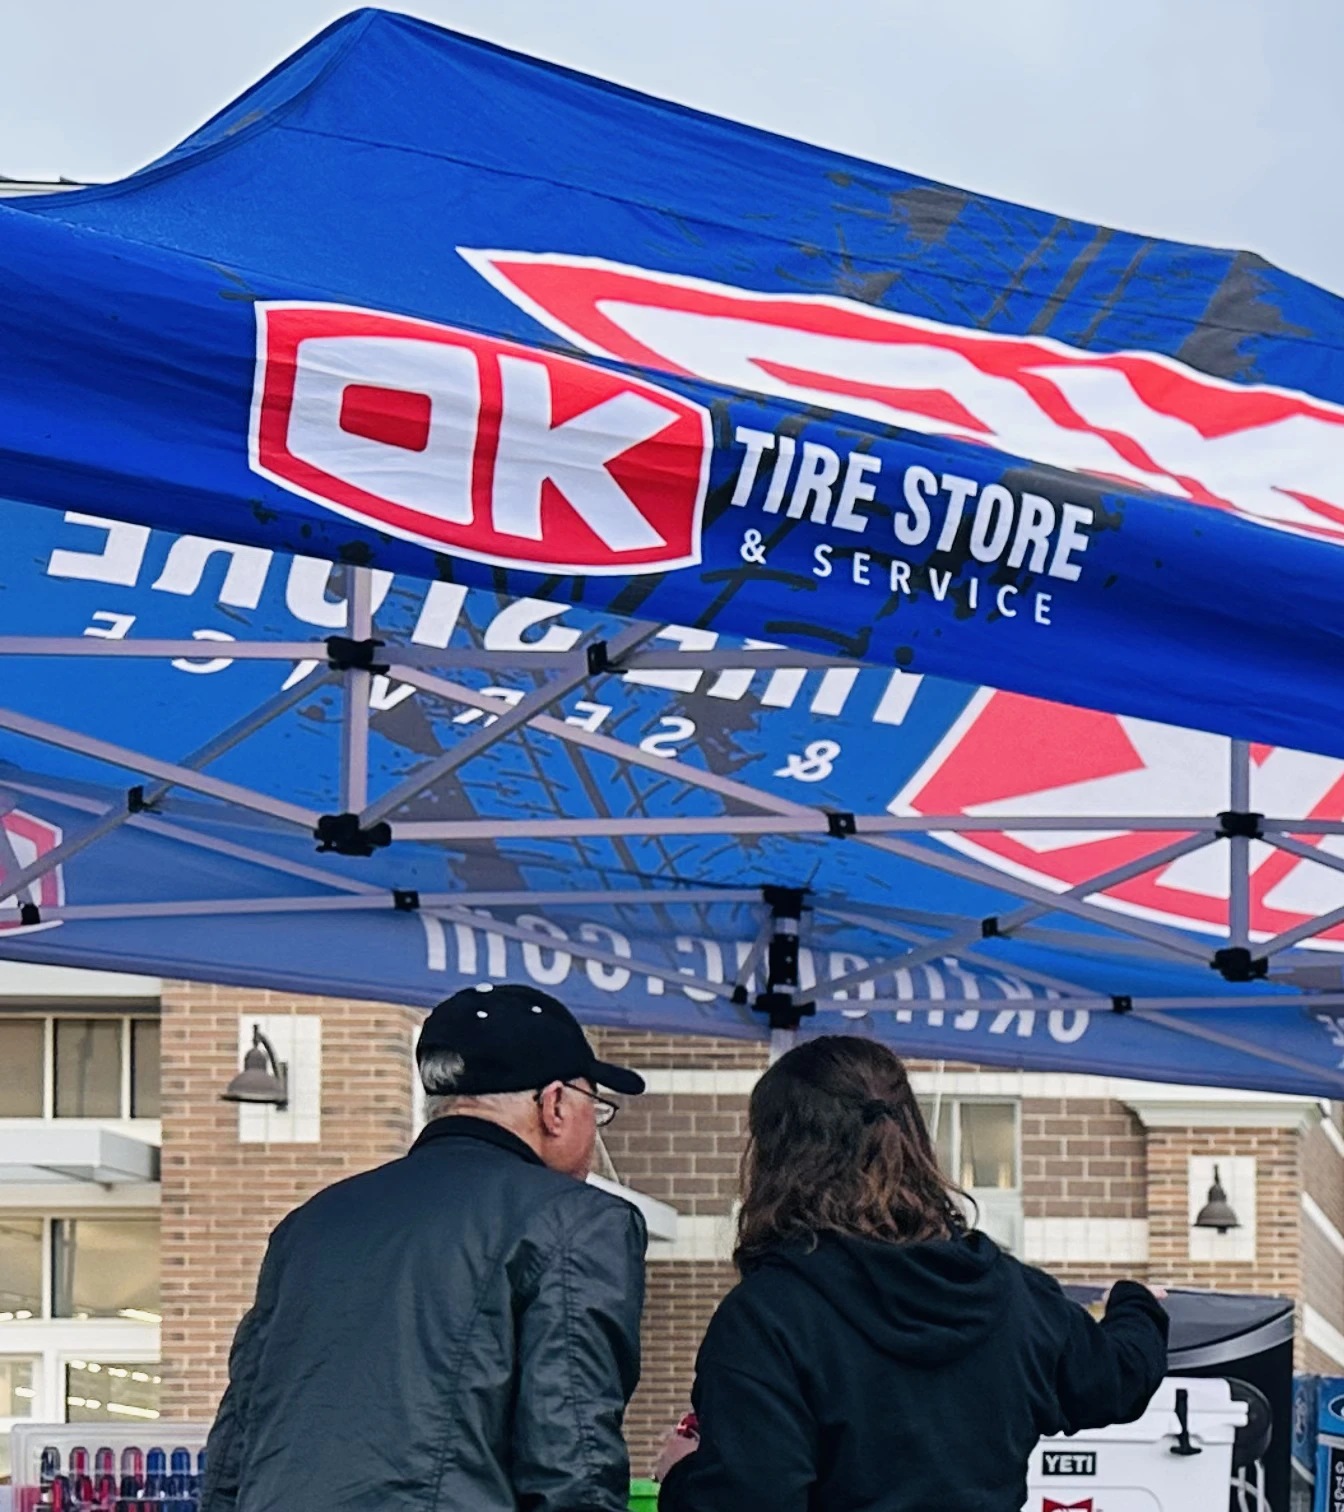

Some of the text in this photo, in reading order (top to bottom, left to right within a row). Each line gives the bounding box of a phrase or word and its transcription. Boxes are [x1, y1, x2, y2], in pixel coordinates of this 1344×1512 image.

[287, 336, 684, 552] OK
[731, 425, 1094, 581] TIRE STORE
[739, 528, 1054, 626] & SERVICE
[1045, 1454, 1093, 1473] YETI
